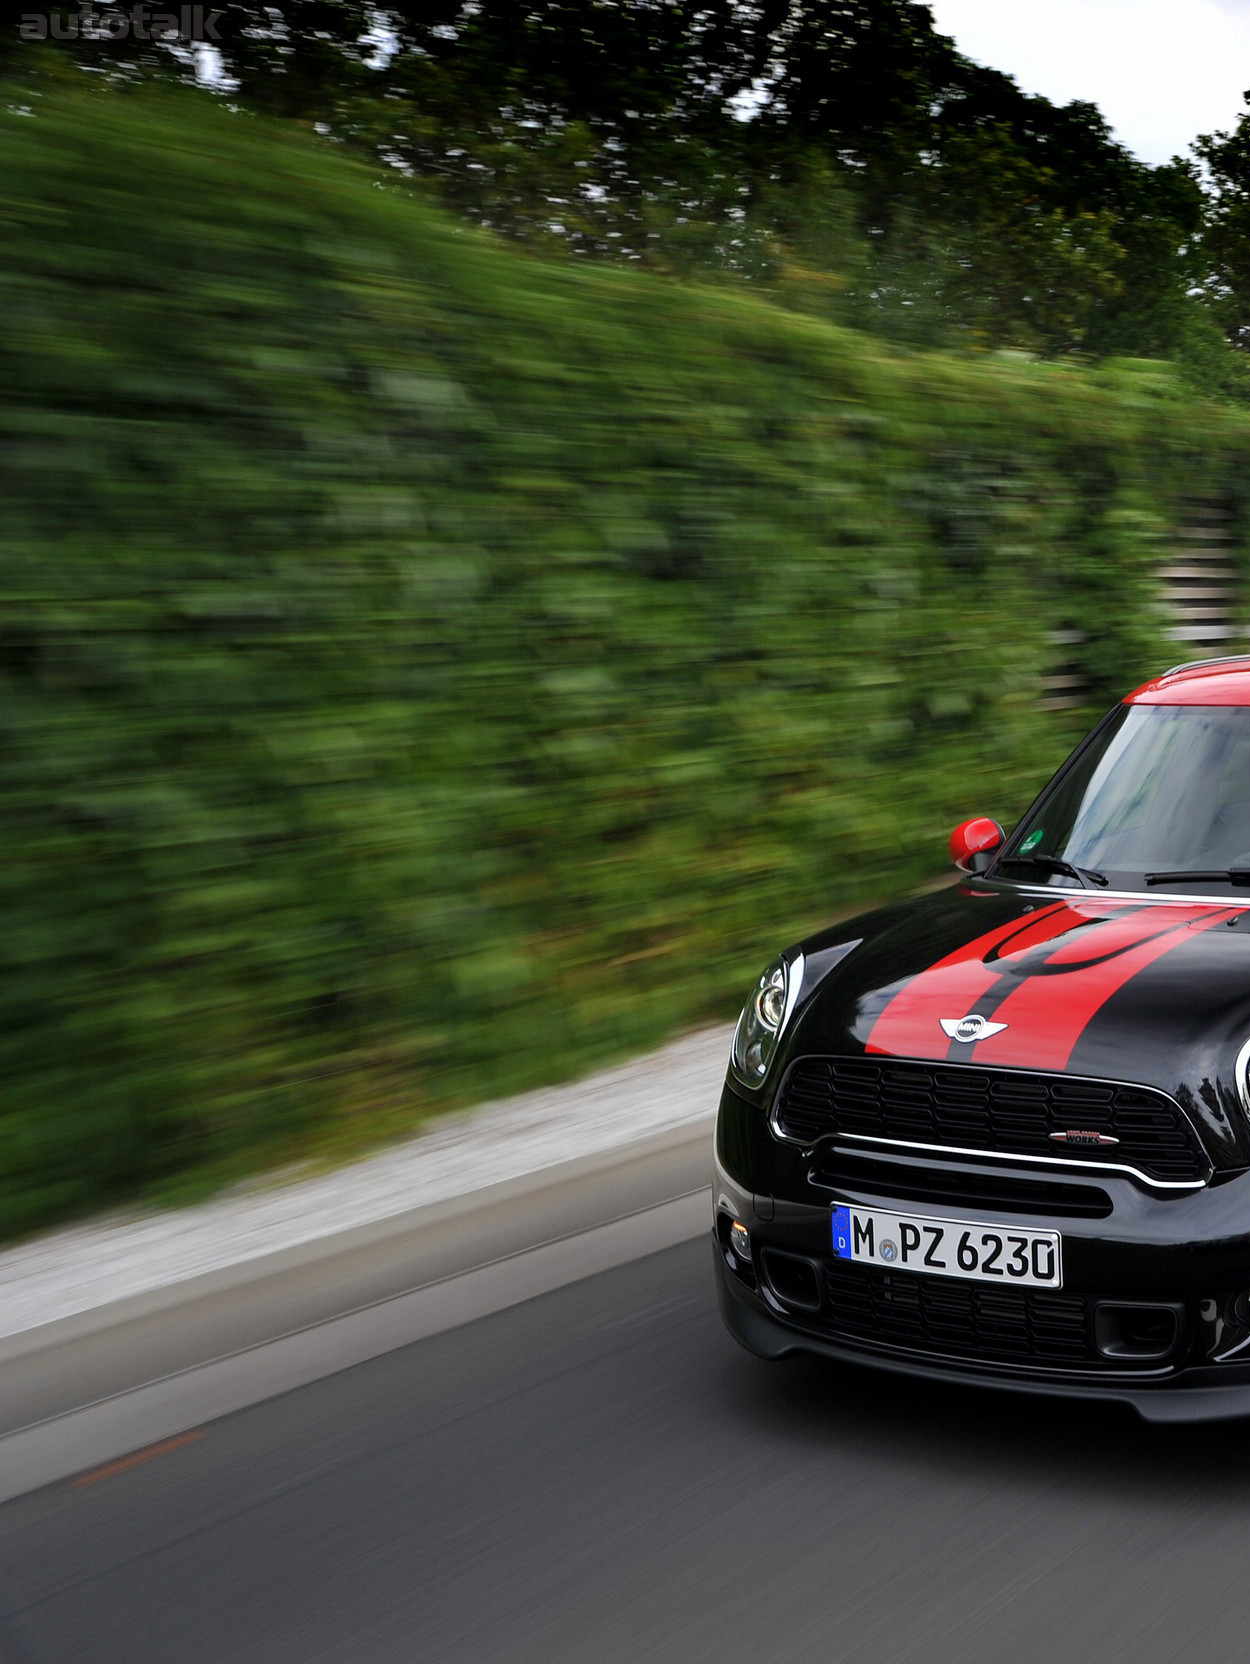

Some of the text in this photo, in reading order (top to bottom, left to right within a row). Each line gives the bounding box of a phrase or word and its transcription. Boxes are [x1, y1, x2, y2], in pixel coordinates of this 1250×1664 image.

[957, 1022, 982, 1032] MINI
[1066, 1135, 1100, 1144] WORKS
[838, 1236, 846, 1249] D
[853, 1214, 1055, 1280] M PZ 6230
